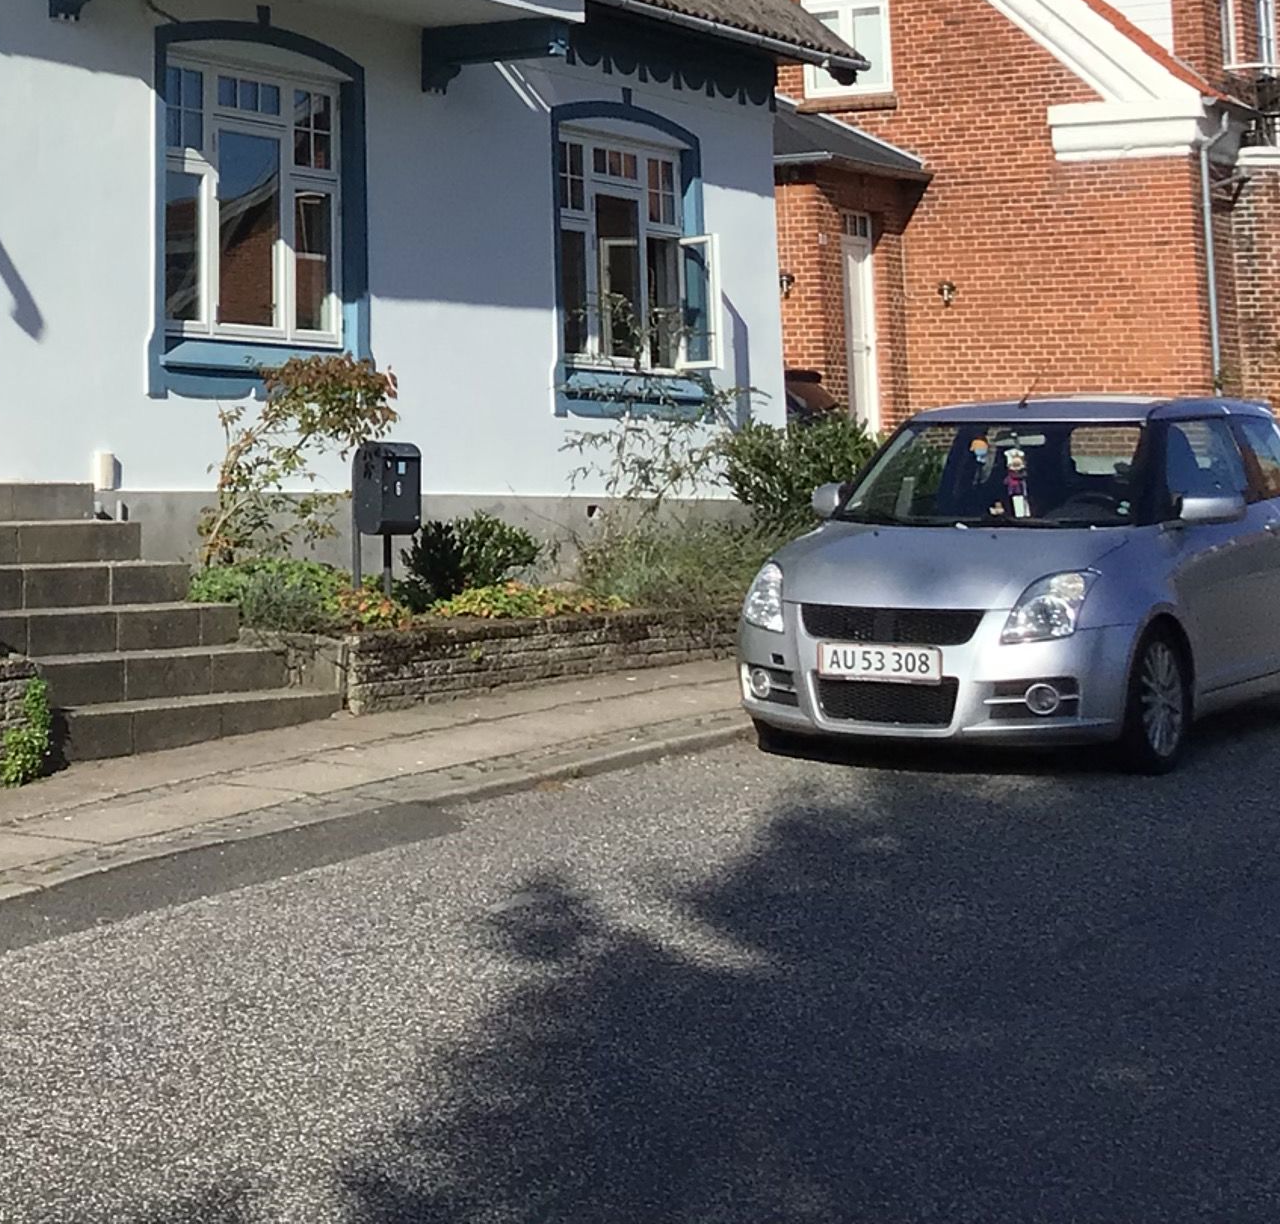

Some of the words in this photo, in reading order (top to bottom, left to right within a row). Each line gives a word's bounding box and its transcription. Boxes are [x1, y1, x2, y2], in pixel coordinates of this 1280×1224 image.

[829, 649, 856, 670] AU
[861, 650, 885, 672] 53
[891, 652, 931, 674] 308
